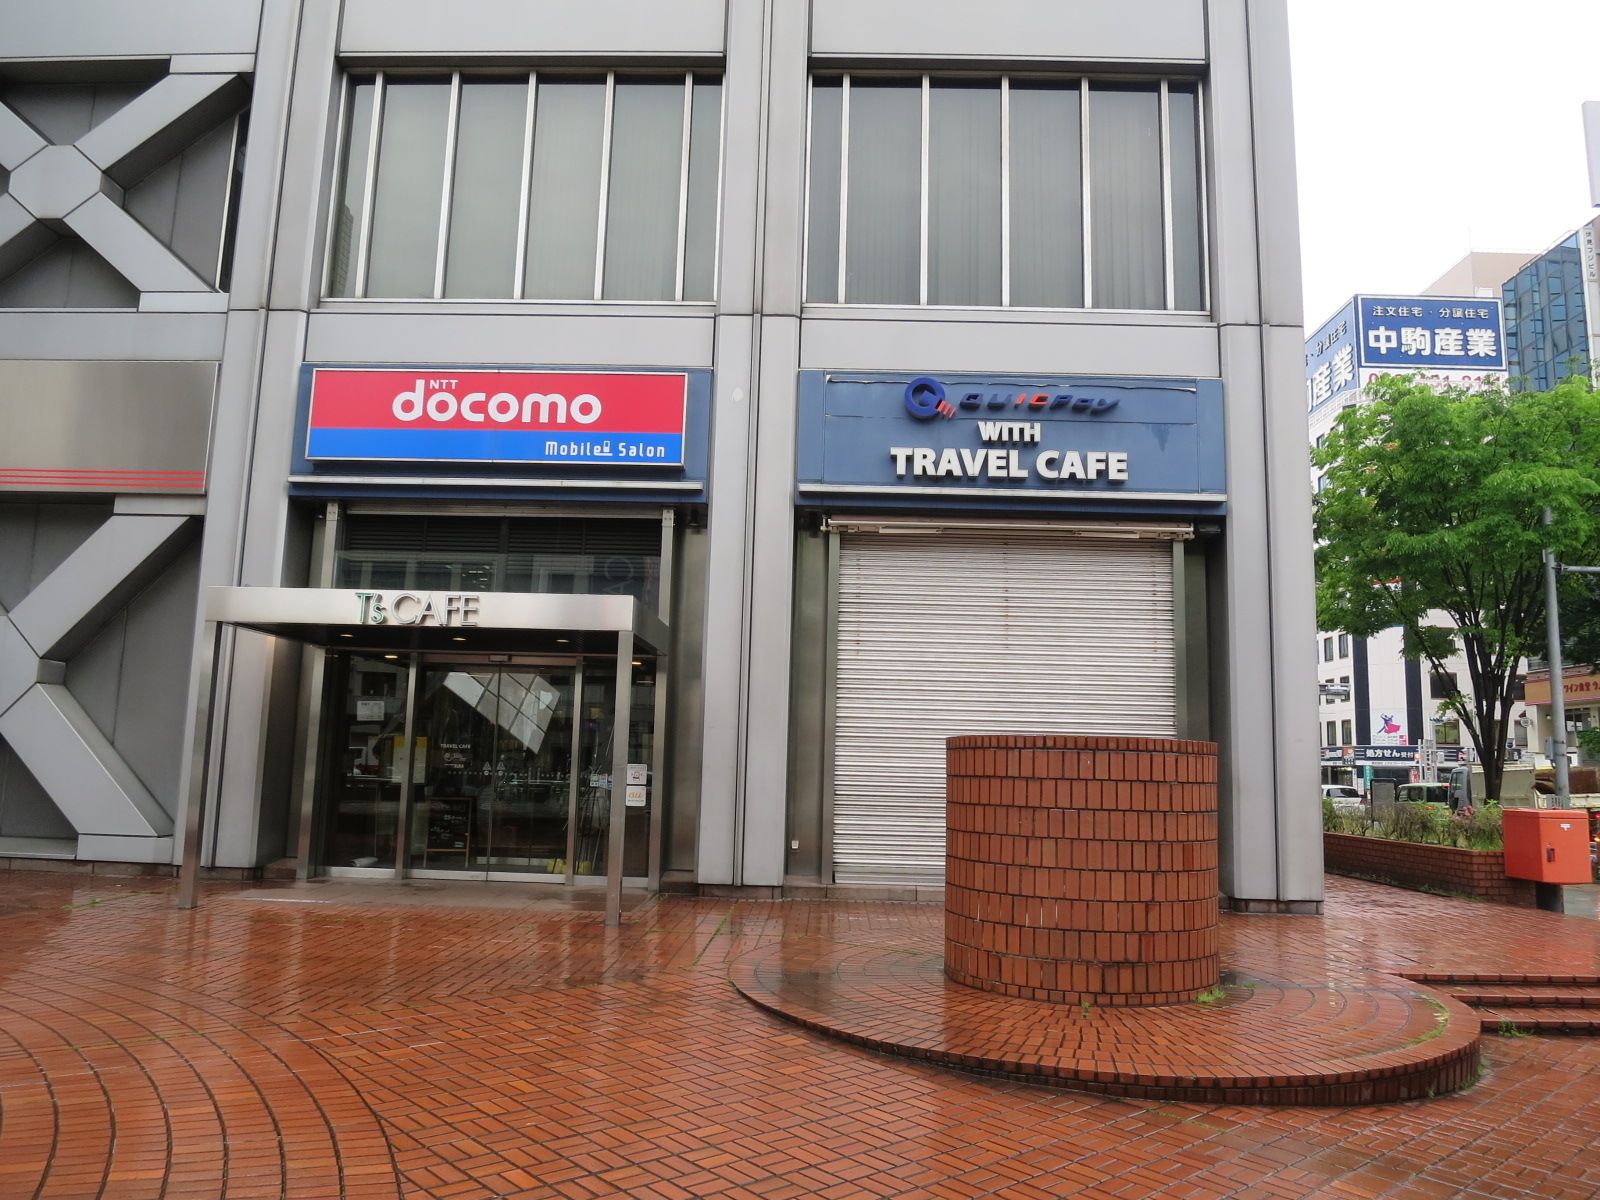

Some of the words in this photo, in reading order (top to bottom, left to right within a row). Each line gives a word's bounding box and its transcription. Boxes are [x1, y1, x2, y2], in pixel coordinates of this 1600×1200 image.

[1368, 325, 1497, 357] 中駒産業
[429, 379, 459, 390] NTT
[392, 379, 602, 424] docomo
[977, 421, 1041, 443] WITH
[545, 441, 602, 456] Mobile
[618, 442, 665, 458] Salon
[890, 447, 1029, 478] TRAVEL
[1035, 450, 1129, 480] CAFE
[355, 593, 387, 625] T's
[391, 593, 480, 626] CAFE
